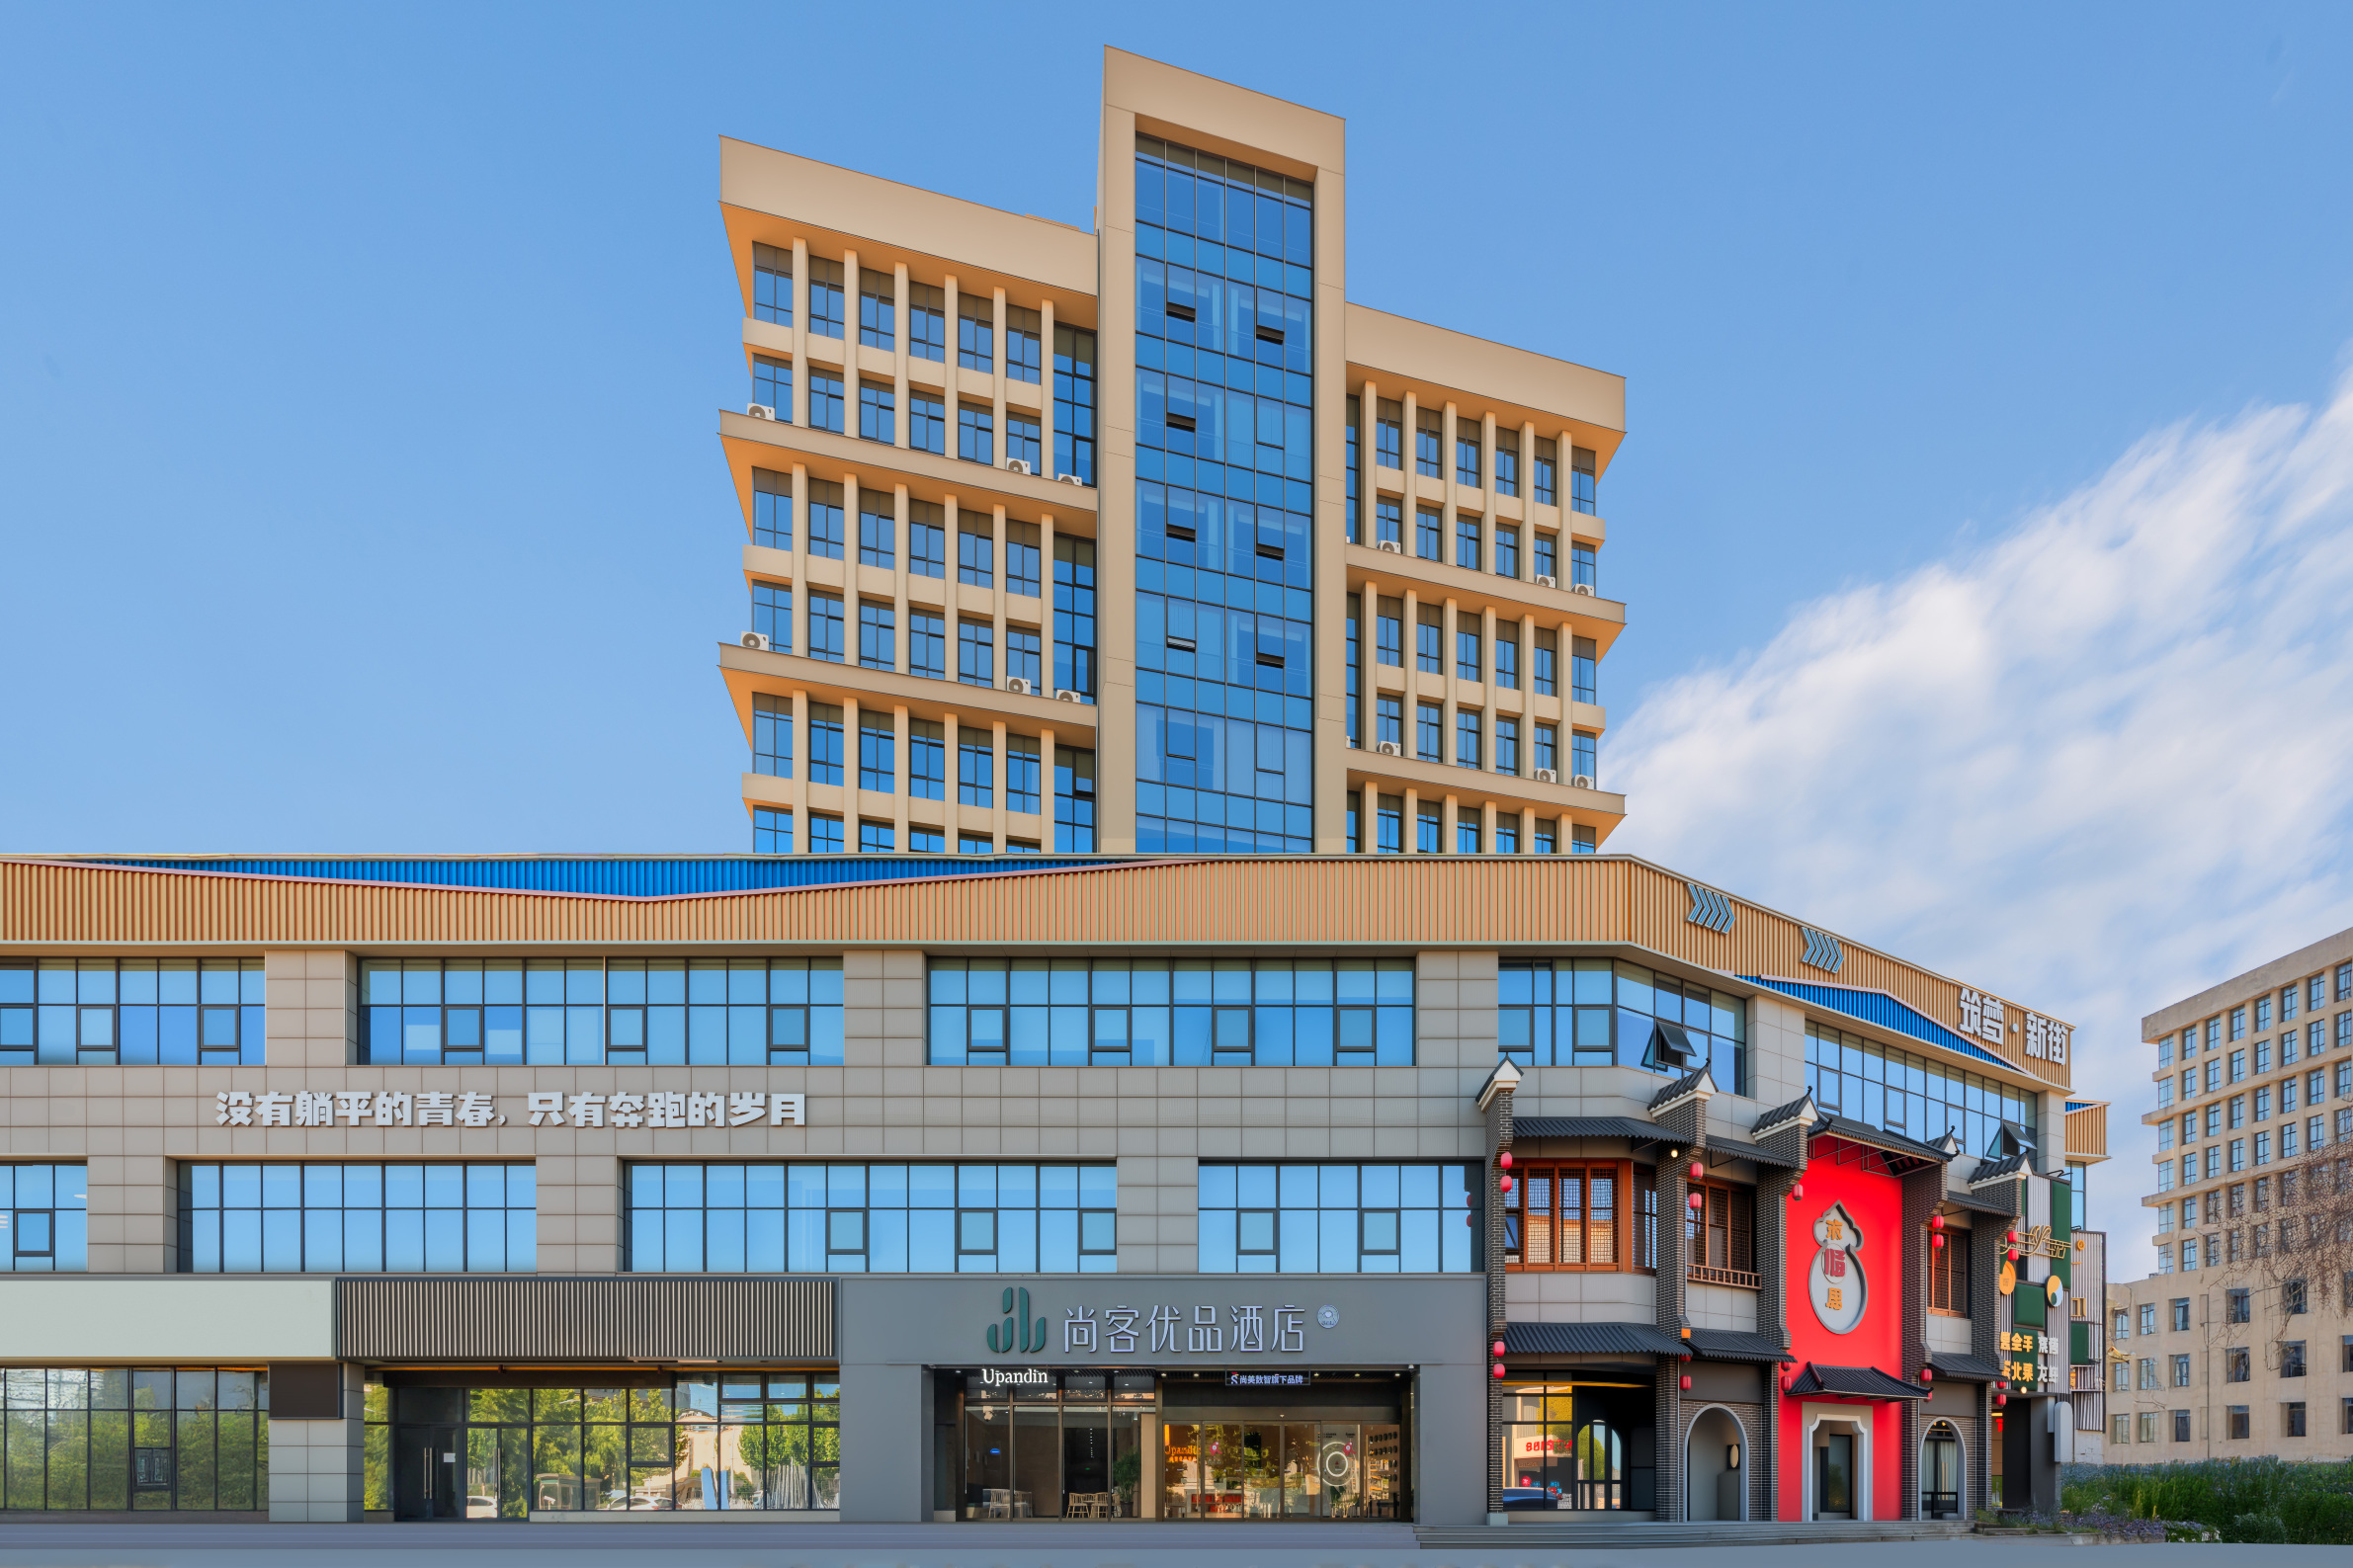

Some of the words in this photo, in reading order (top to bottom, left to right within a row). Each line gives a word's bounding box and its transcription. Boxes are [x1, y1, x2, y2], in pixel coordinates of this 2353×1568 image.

[1959, 987, 2068, 1066] 筑梦·新街
[1064, 1304, 1305, 1353] 尚客优品酒店
[981, 1368, 1049, 1387] Upandin
